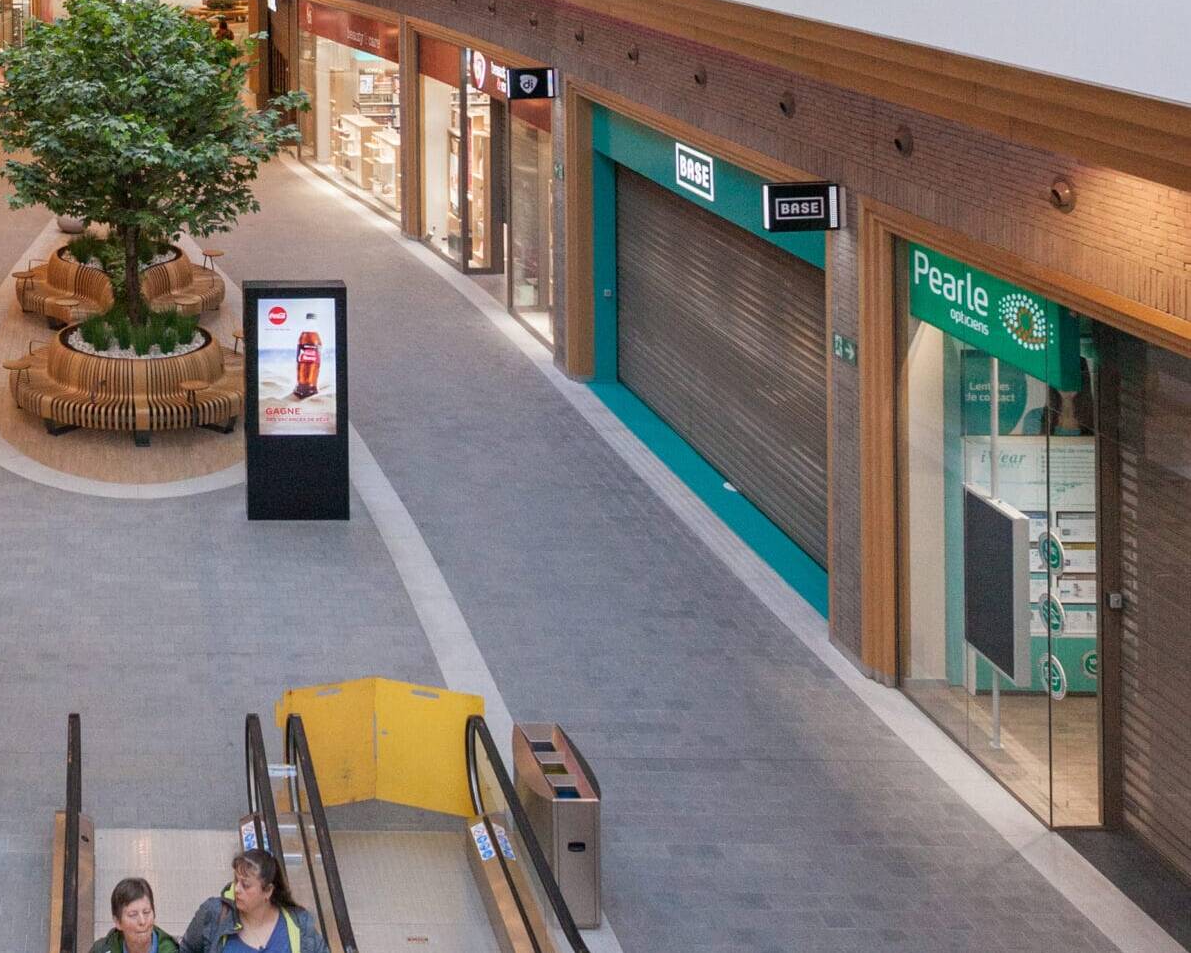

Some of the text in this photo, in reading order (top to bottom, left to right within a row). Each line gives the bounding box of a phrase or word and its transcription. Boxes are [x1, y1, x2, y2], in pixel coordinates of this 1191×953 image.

[679, 155, 710, 189] BASE
[780, 201, 820, 216] BASE
[914, 249, 988, 317] Pearle
[950, 308, 989, 336] opticiens
[265, 407, 302, 416] GAGNE
